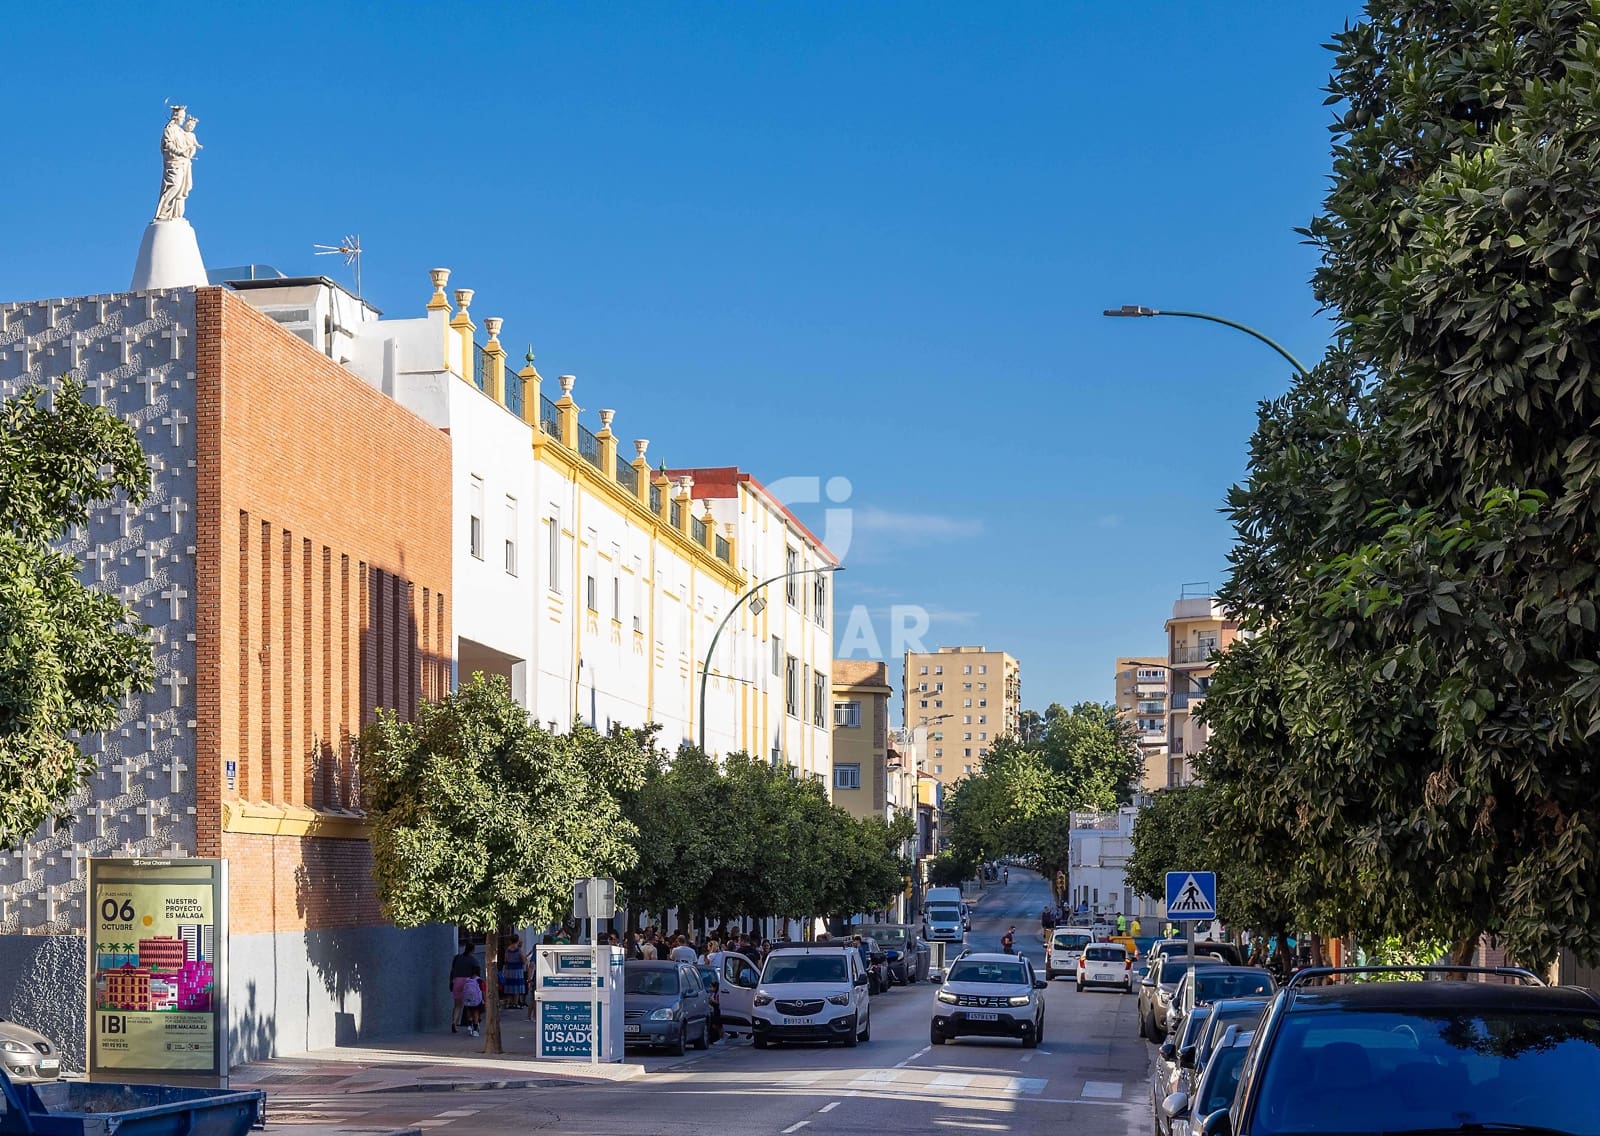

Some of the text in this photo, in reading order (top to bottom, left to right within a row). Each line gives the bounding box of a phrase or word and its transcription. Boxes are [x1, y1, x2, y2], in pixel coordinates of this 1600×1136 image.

[101, 898, 135, 922] 06
[175, 911, 204, 919] MÁLAGA
[101, 923, 133, 931] OCTUBRE
[101, 1015, 127, 1034] IBI
[544, 1023, 598, 1031] ROPA Y CALZAD
